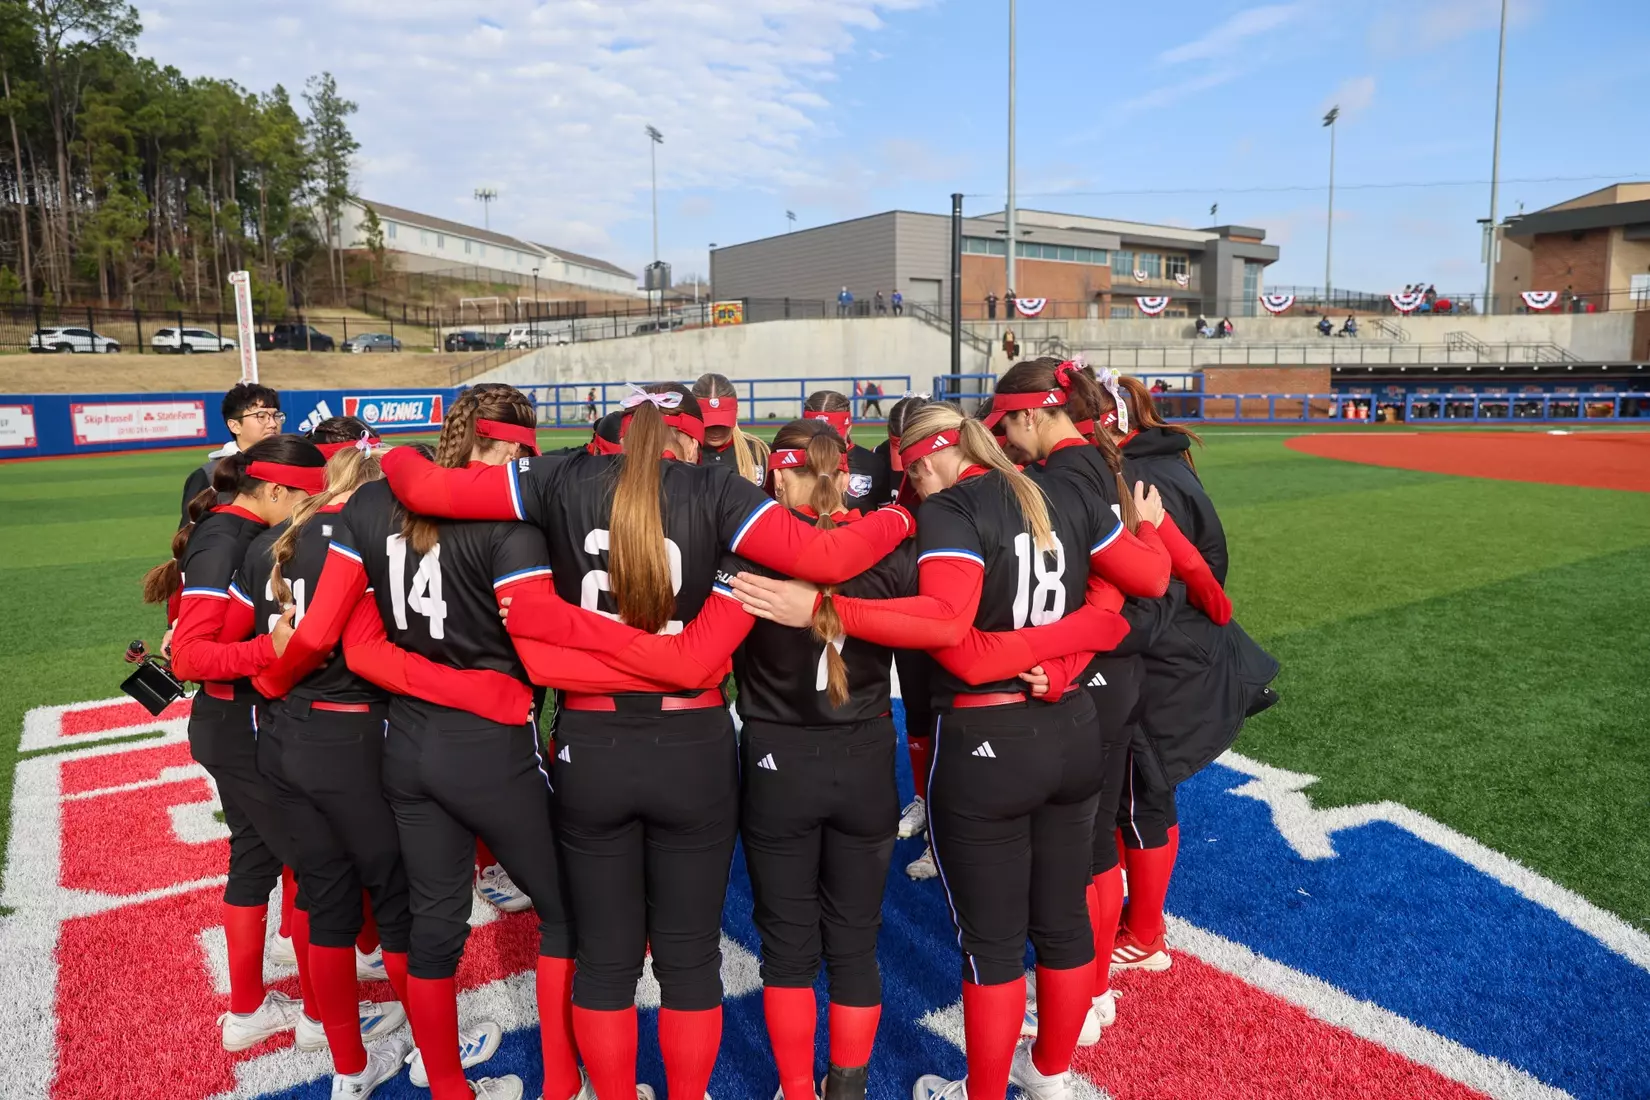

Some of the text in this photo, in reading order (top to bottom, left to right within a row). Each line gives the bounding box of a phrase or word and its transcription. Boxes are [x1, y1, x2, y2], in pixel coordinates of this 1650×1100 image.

[84, 413, 133, 425] Skip Russell
[381, 401, 423, 421] KENNEL
[386, 533, 447, 640] 14
[1012, 530, 1066, 630] 18
